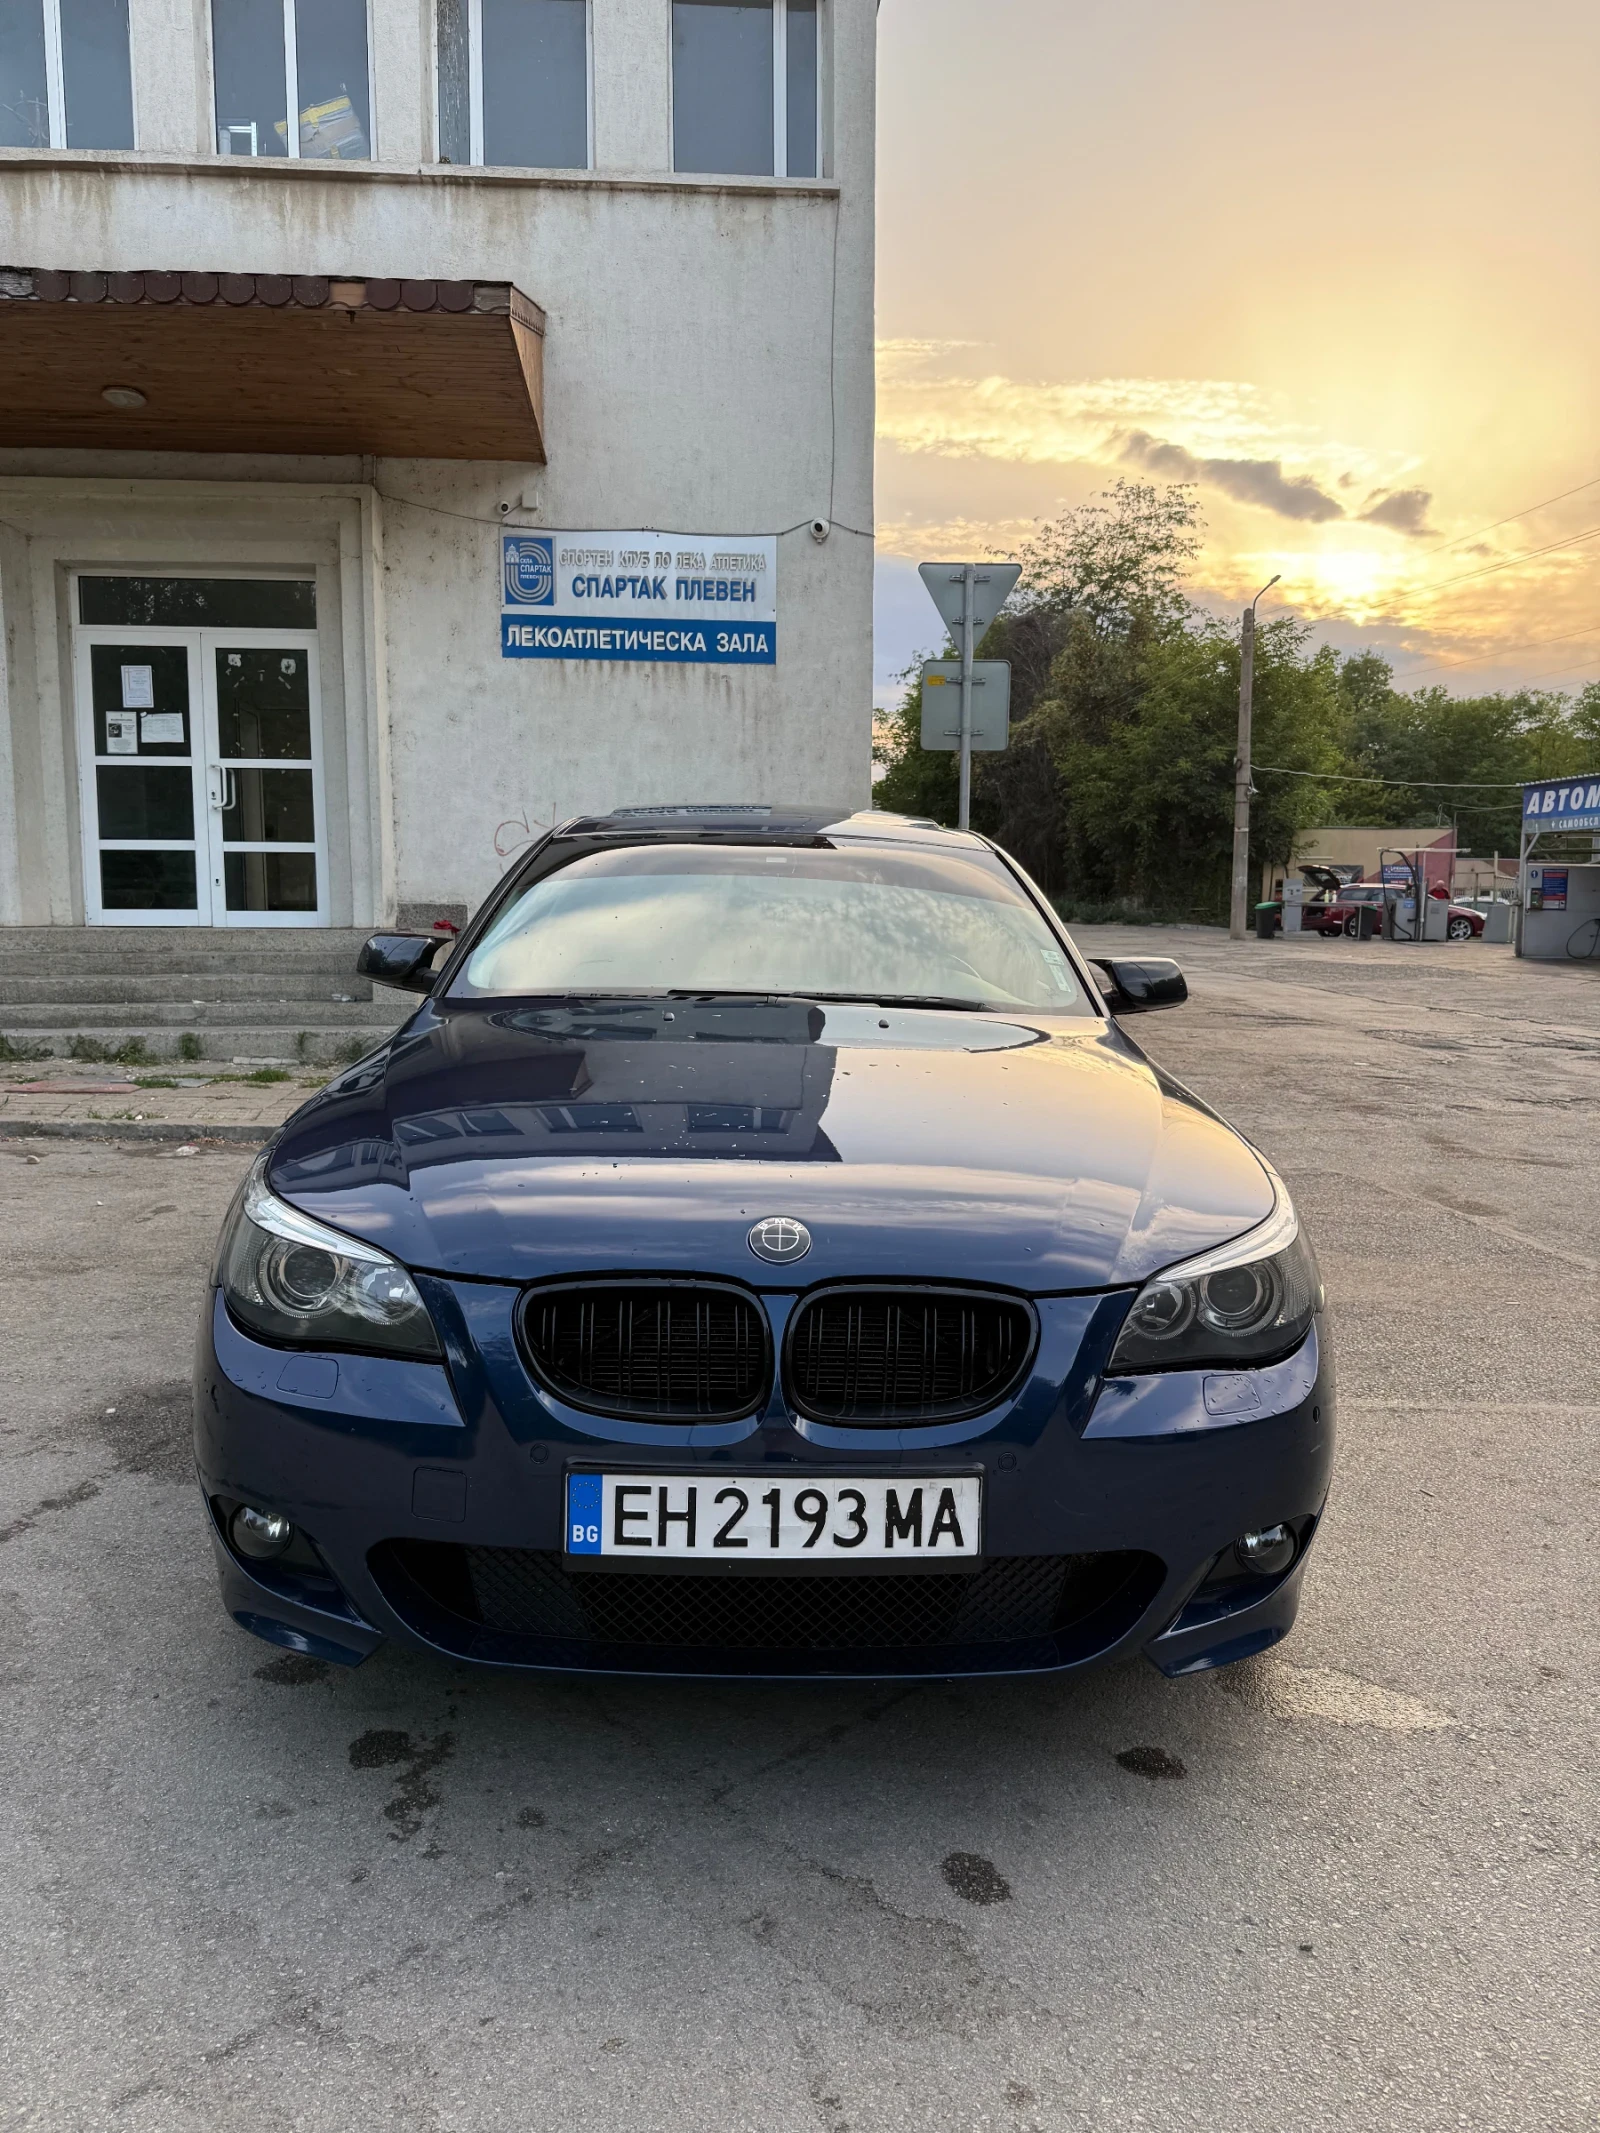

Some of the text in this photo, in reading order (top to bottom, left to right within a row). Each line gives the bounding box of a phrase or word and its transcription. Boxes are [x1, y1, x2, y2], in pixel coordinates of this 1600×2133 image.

[520, 564, 552, 573] СПАРТАК
[560, 550, 766, 571] СПОРТЕН КЛУБ ПО ЛЕКА АТЛЕТИКА
[572, 576, 755, 602] СПАРТАК ПЛЕВЕН
[506, 625, 769, 653] ЛЕКОАТЛЕТИЧЕСКА ЗАЛА
[1558, 816, 1600, 829] САМООБСЛ
[572, 1524, 599, 1544] BG
